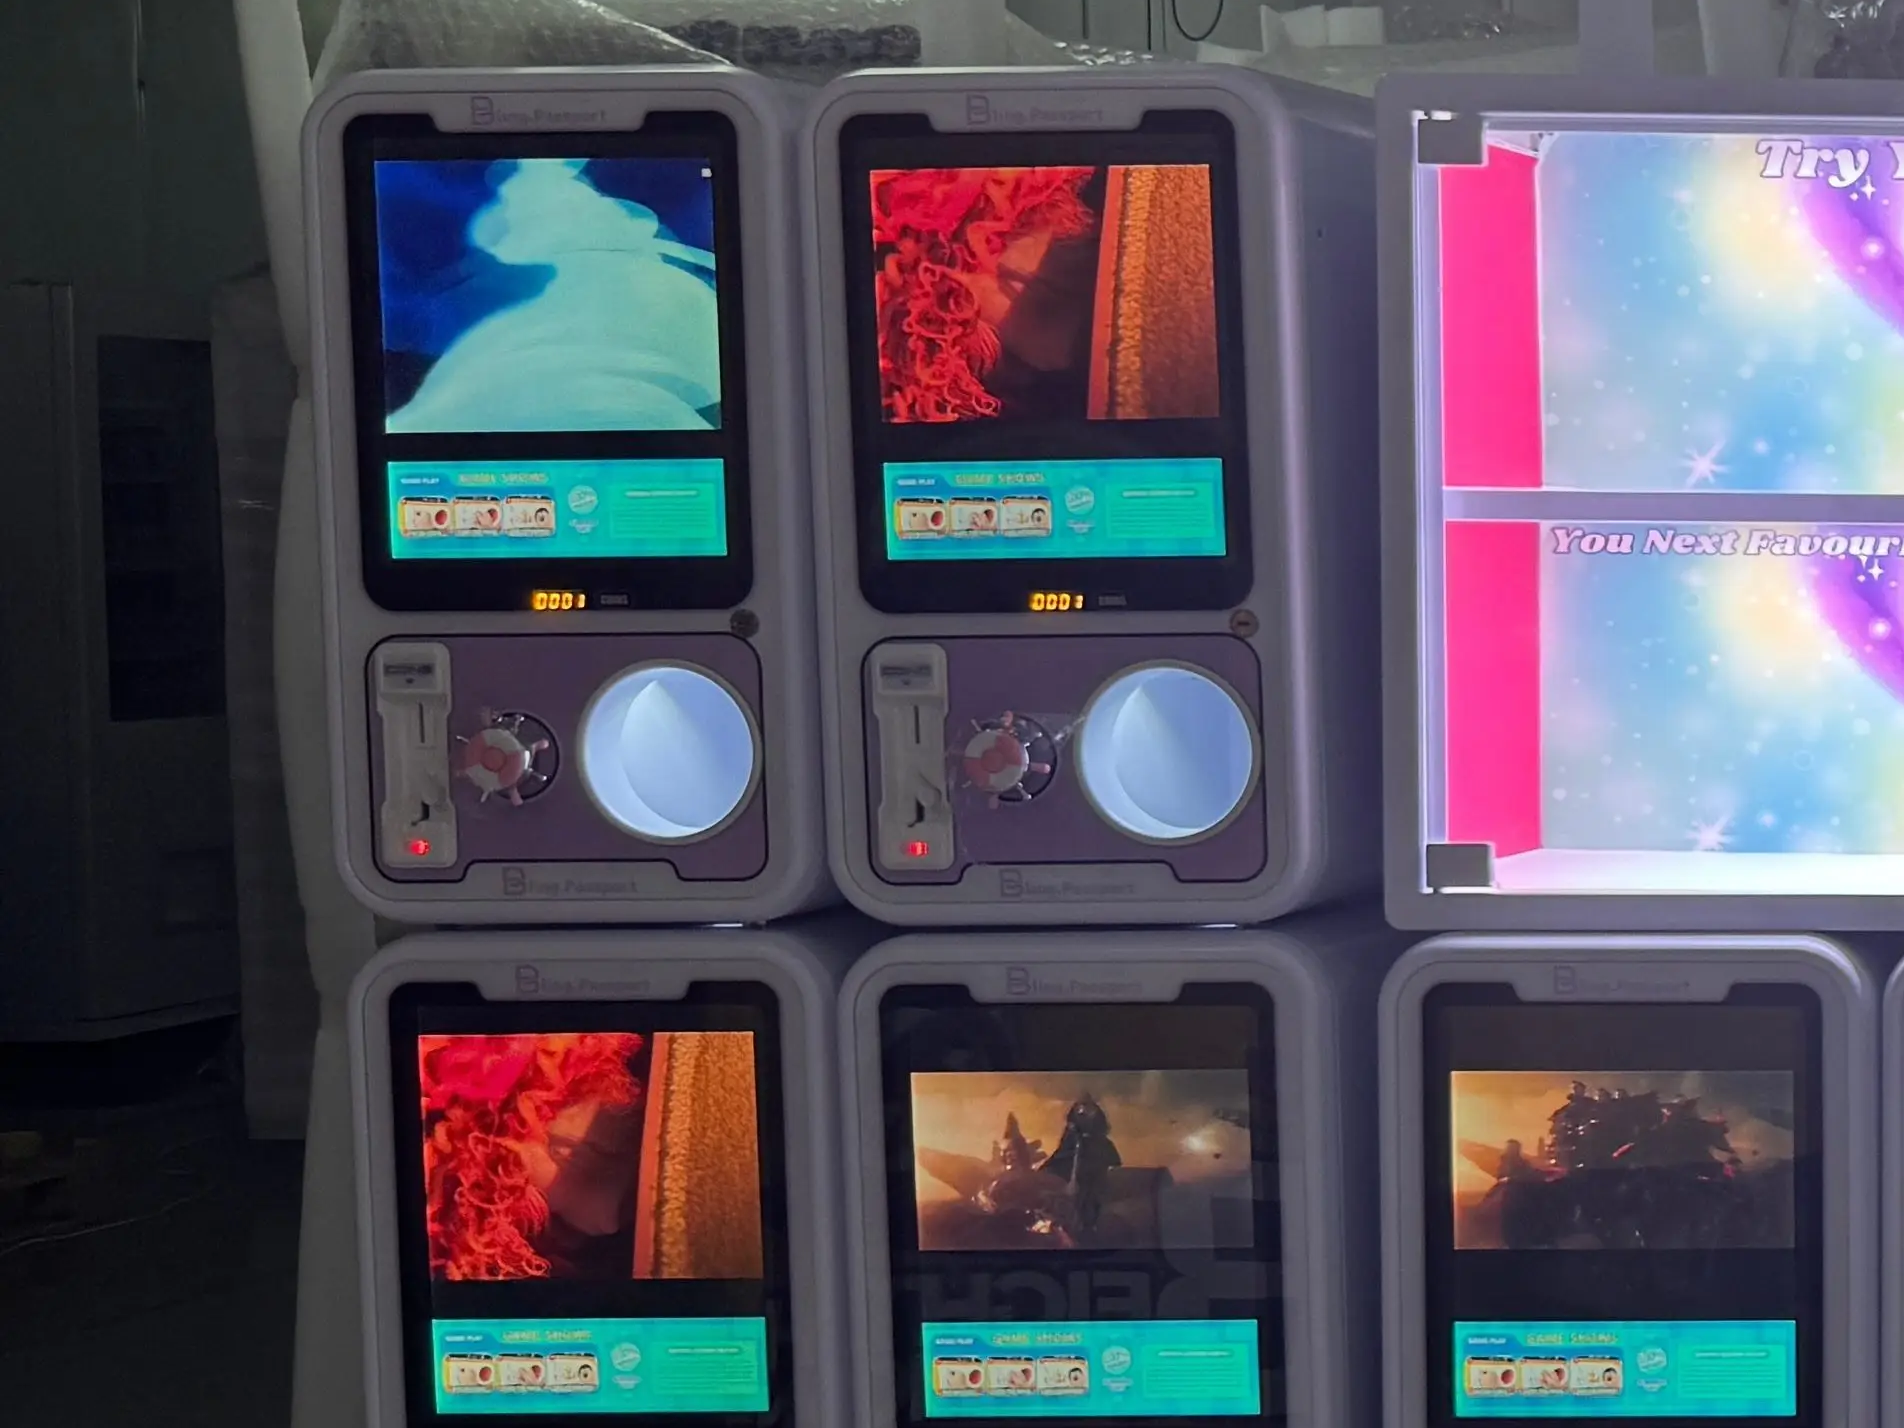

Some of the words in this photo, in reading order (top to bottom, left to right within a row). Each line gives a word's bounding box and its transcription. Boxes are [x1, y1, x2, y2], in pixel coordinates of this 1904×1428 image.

[1755, 140, 1869, 186] Try
[1551, 529, 1637, 557] You
[1642, 529, 1739, 557] Next
[535, 593, 585, 610] 0001
[1032, 593, 1083, 610] 0001
